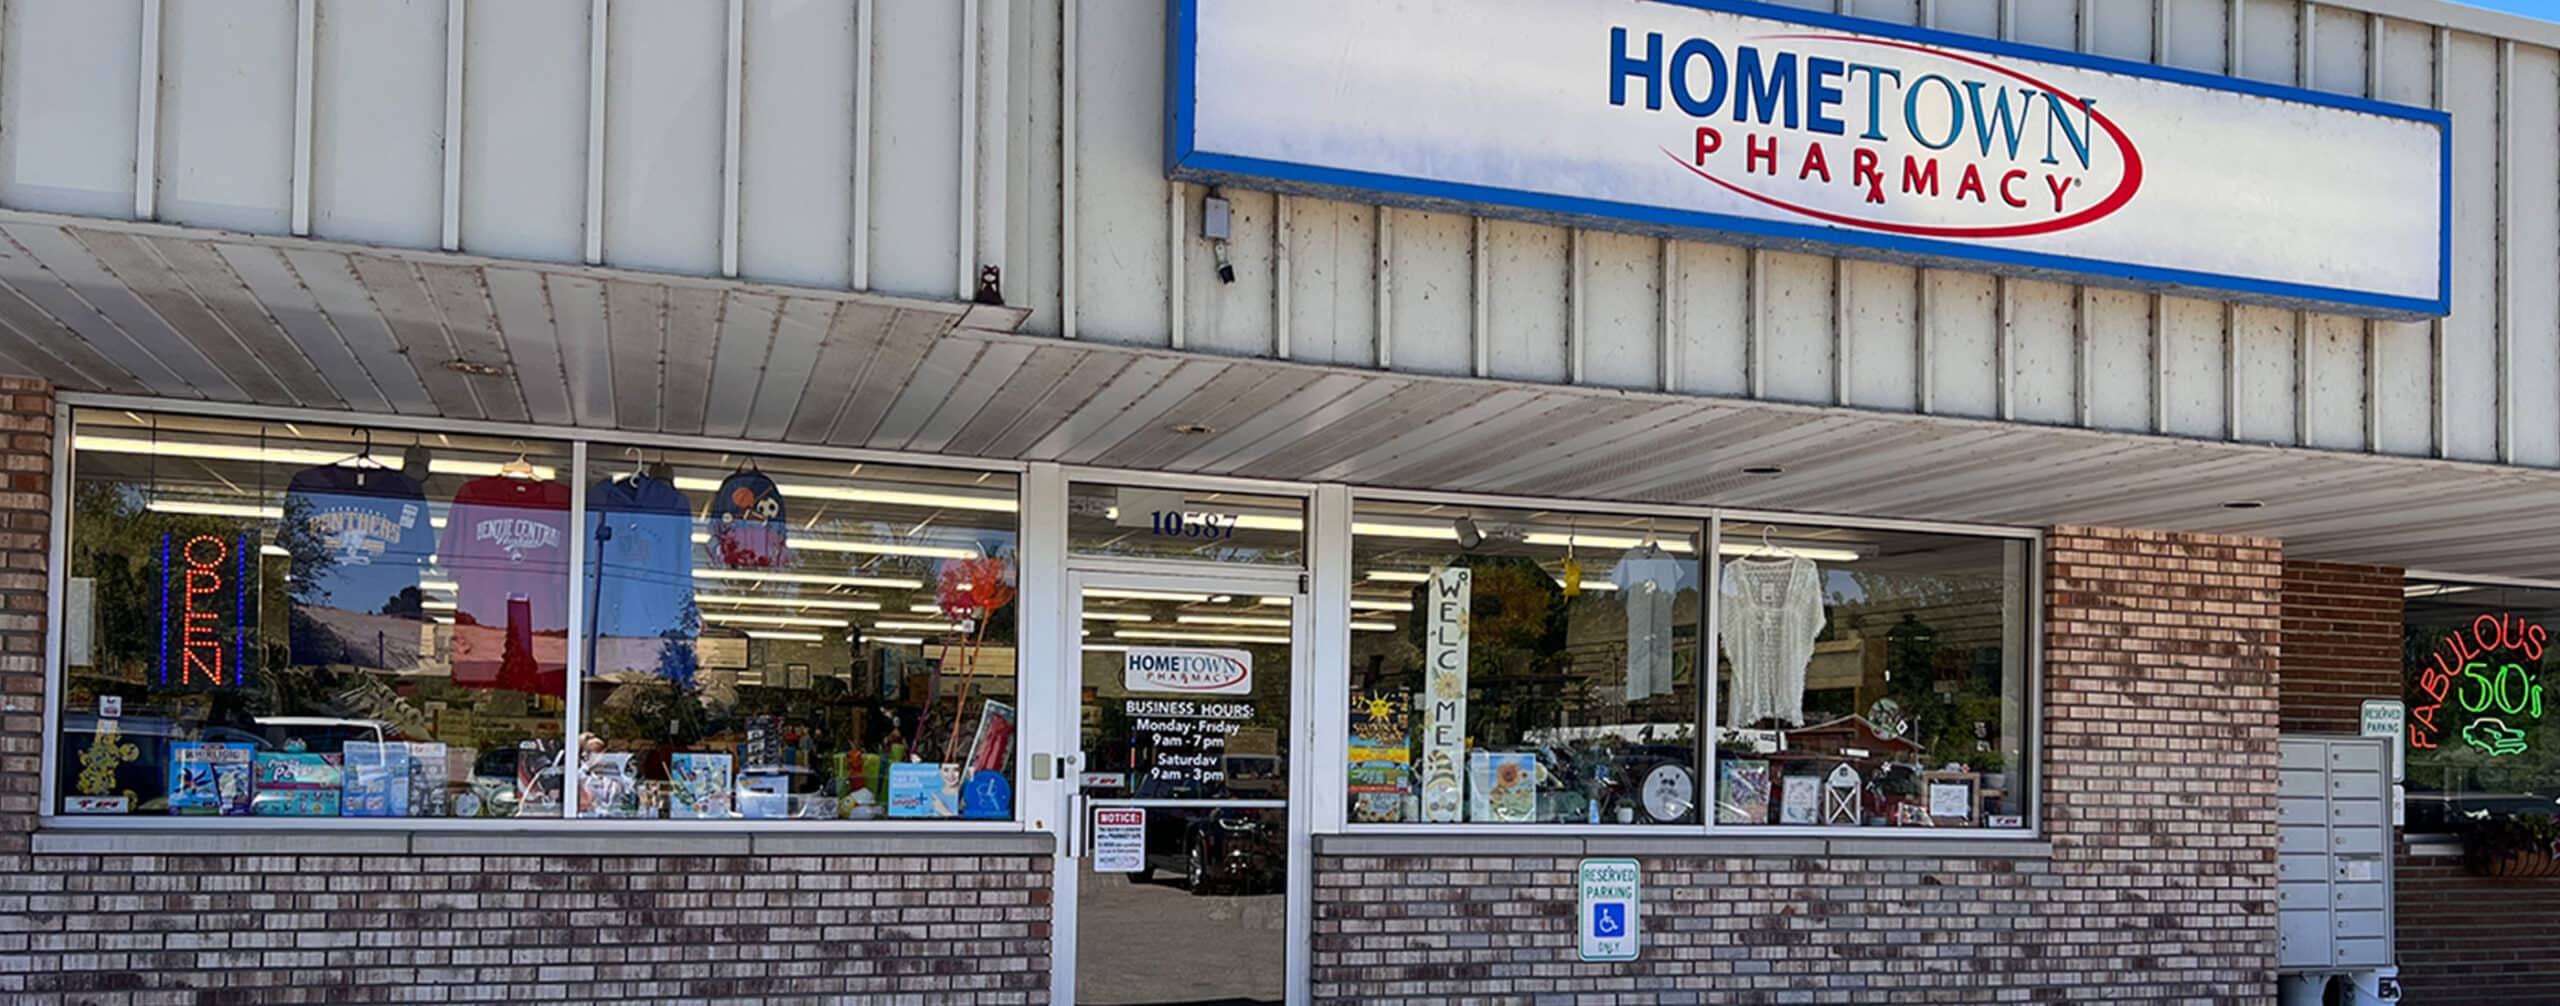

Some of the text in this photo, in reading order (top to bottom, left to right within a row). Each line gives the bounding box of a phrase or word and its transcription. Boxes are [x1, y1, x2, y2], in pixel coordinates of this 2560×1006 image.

[1609, 26, 2097, 170] HOMETOWN
[1695, 126, 2072, 213] PHARMACY
[1151, 510, 1238, 539] 10587
[183, 534, 227, 685] OPEN
[1129, 655, 1236, 674] HOMETOWN
[1146, 672, 1232, 684] PHARMACY
[2410, 612, 2547, 749] FABULOUS
[1126, 701, 1255, 718] BUSINESS HOURS:
[1158, 753, 1218, 766] Saturday
[1584, 868, 1635, 882] RESERVED
[1586, 886, 1633, 899] PARKING
